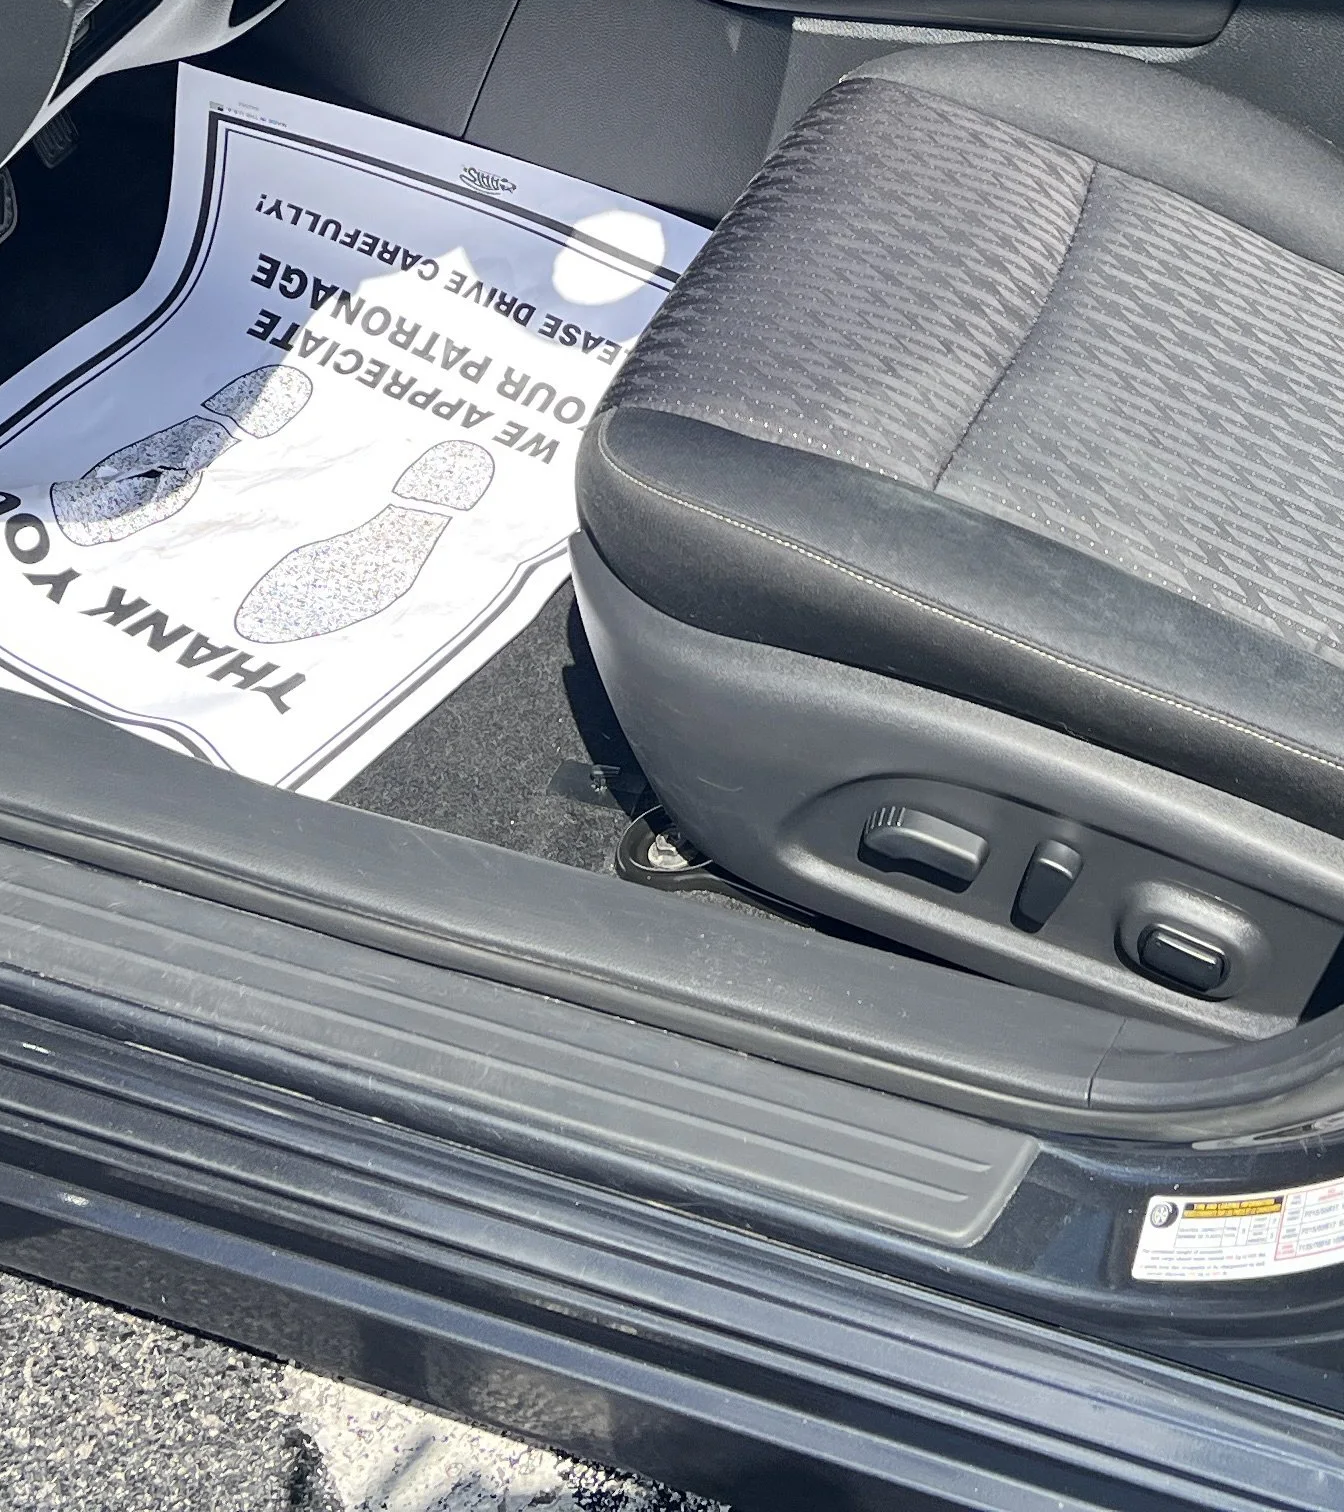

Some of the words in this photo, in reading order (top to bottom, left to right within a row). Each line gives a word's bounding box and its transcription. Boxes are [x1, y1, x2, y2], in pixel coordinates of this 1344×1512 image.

[256, 192, 440, 280] CAREFULLY!
[250, 252, 493, 385] PATRONAGE
[443, 269, 537, 328] DRIVE
[245, 308, 496, 428] APPRECIATE
[537, 313, 631, 366] EASE
[496, 366, 588, 432] OUR
[491, 420, 561, 464] WE
[78, 585, 307, 714] THANK
